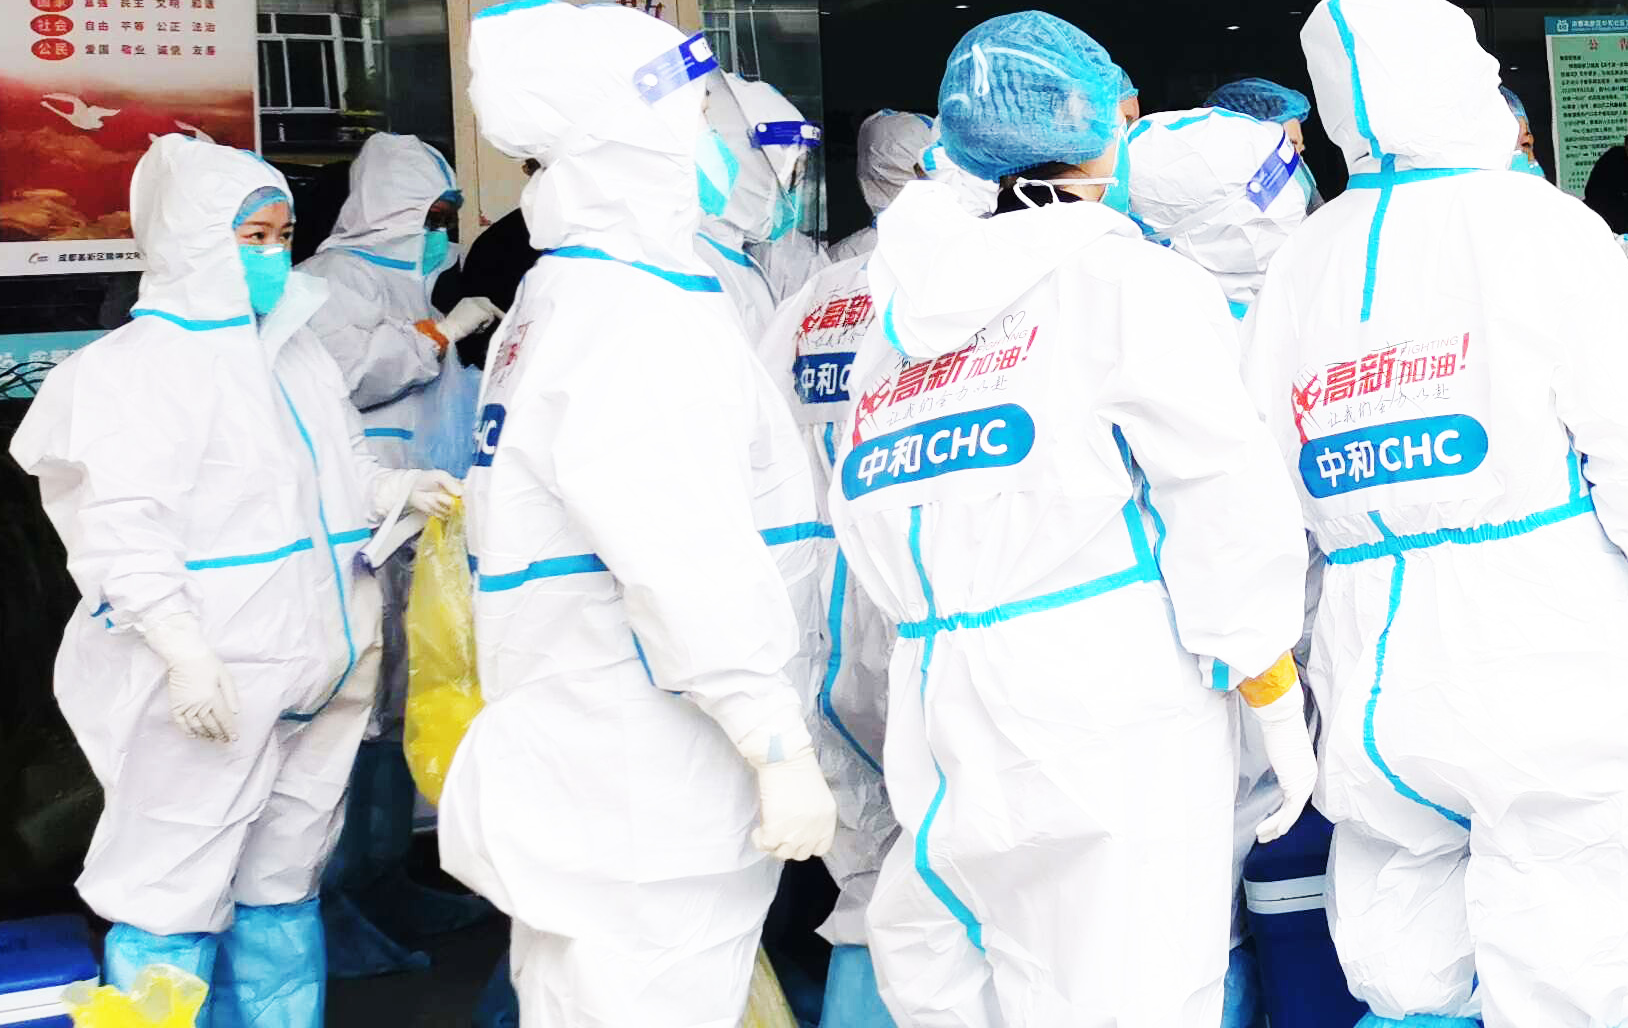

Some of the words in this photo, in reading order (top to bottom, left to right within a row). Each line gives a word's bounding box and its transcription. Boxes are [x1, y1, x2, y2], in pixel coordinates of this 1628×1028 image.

[38, 19, 68, 32] 社会
[85, 21, 109, 32] 自由
[121, 21, 145, 32] 平等
[157, 22, 181, 32] 公正
[39, 42, 69, 56] 公民
[857, 419, 1008, 487] 中和CHC
[1316, 429, 1462, 488] 中和CHC
